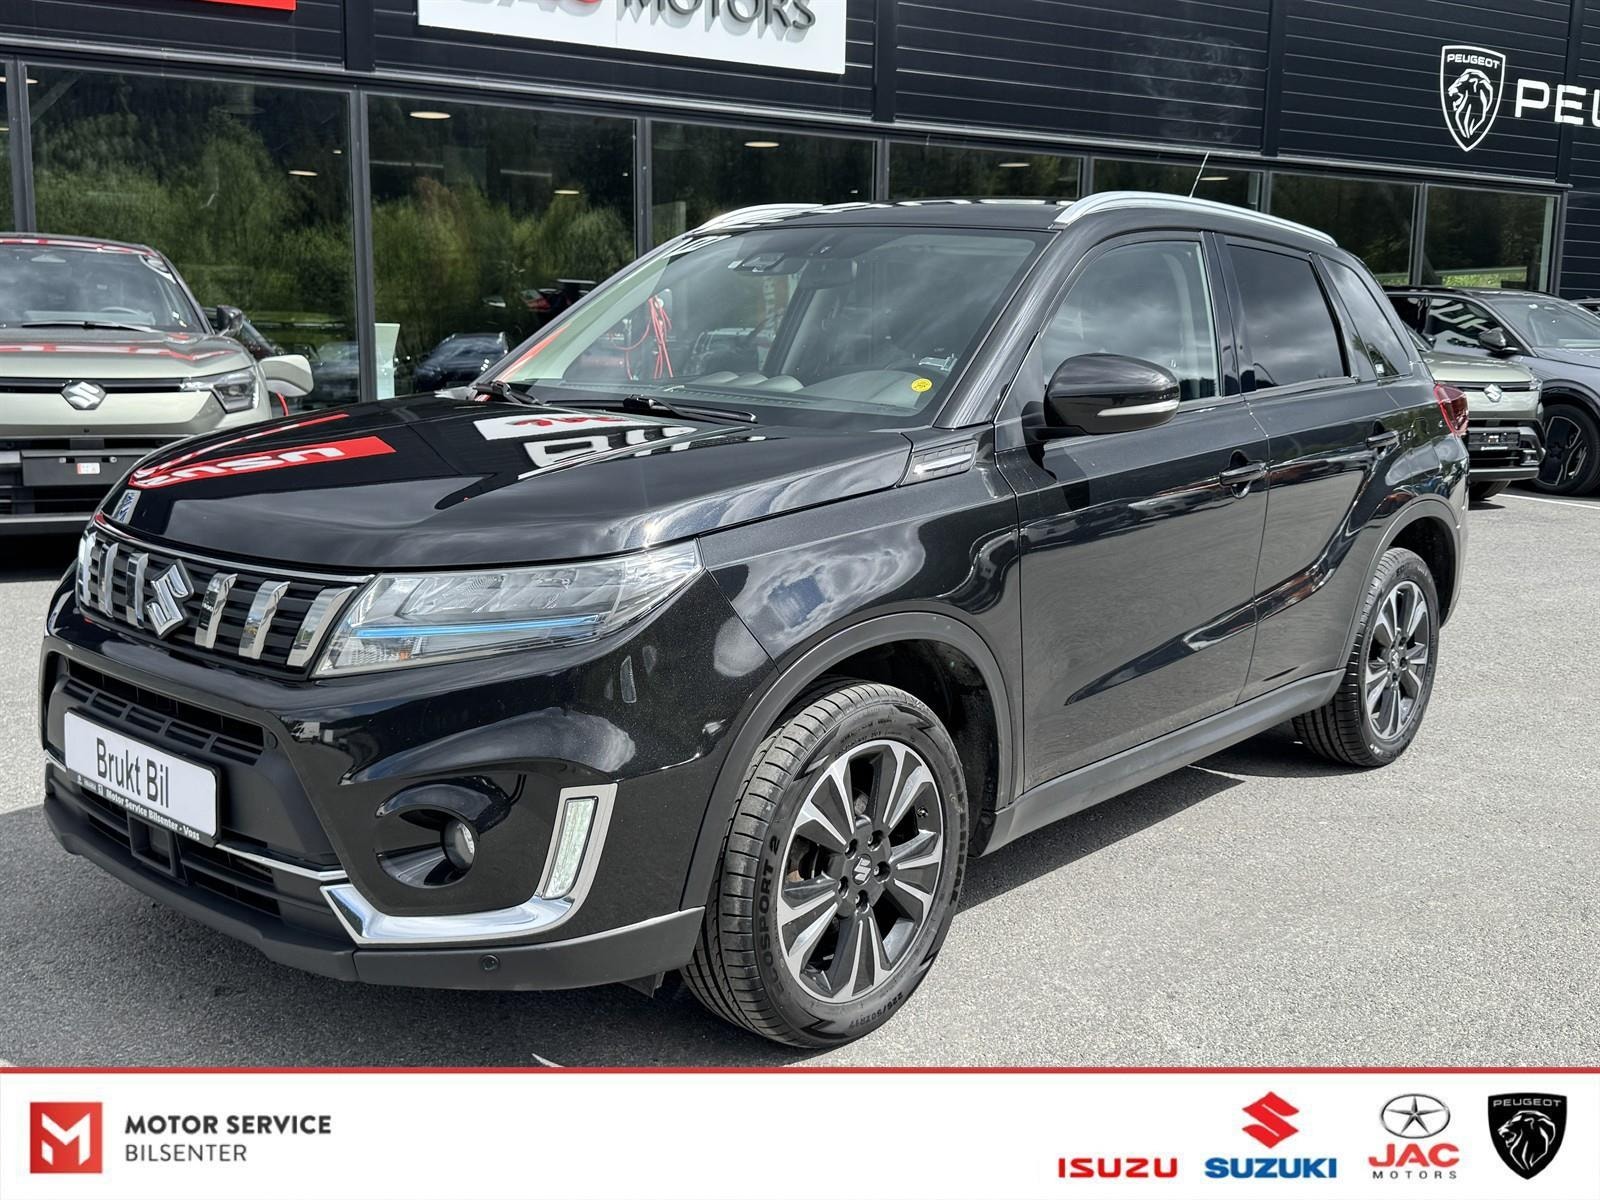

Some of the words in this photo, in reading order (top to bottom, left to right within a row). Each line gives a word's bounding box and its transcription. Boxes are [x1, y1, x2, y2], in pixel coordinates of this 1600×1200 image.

[1446, 53, 1501, 69] PEUGEOT
[1514, 78, 1600, 128] PE
[96, 736, 141, 796] Brukt
[147, 758, 170, 809] Bil
[106, 789, 124, 806] Motor
[125, 798, 148, 818] Service
[148, 809, 178, 832] Bilsenter
[183, 825, 201, 841] Voss
[769, 835, 780, 856] 2
